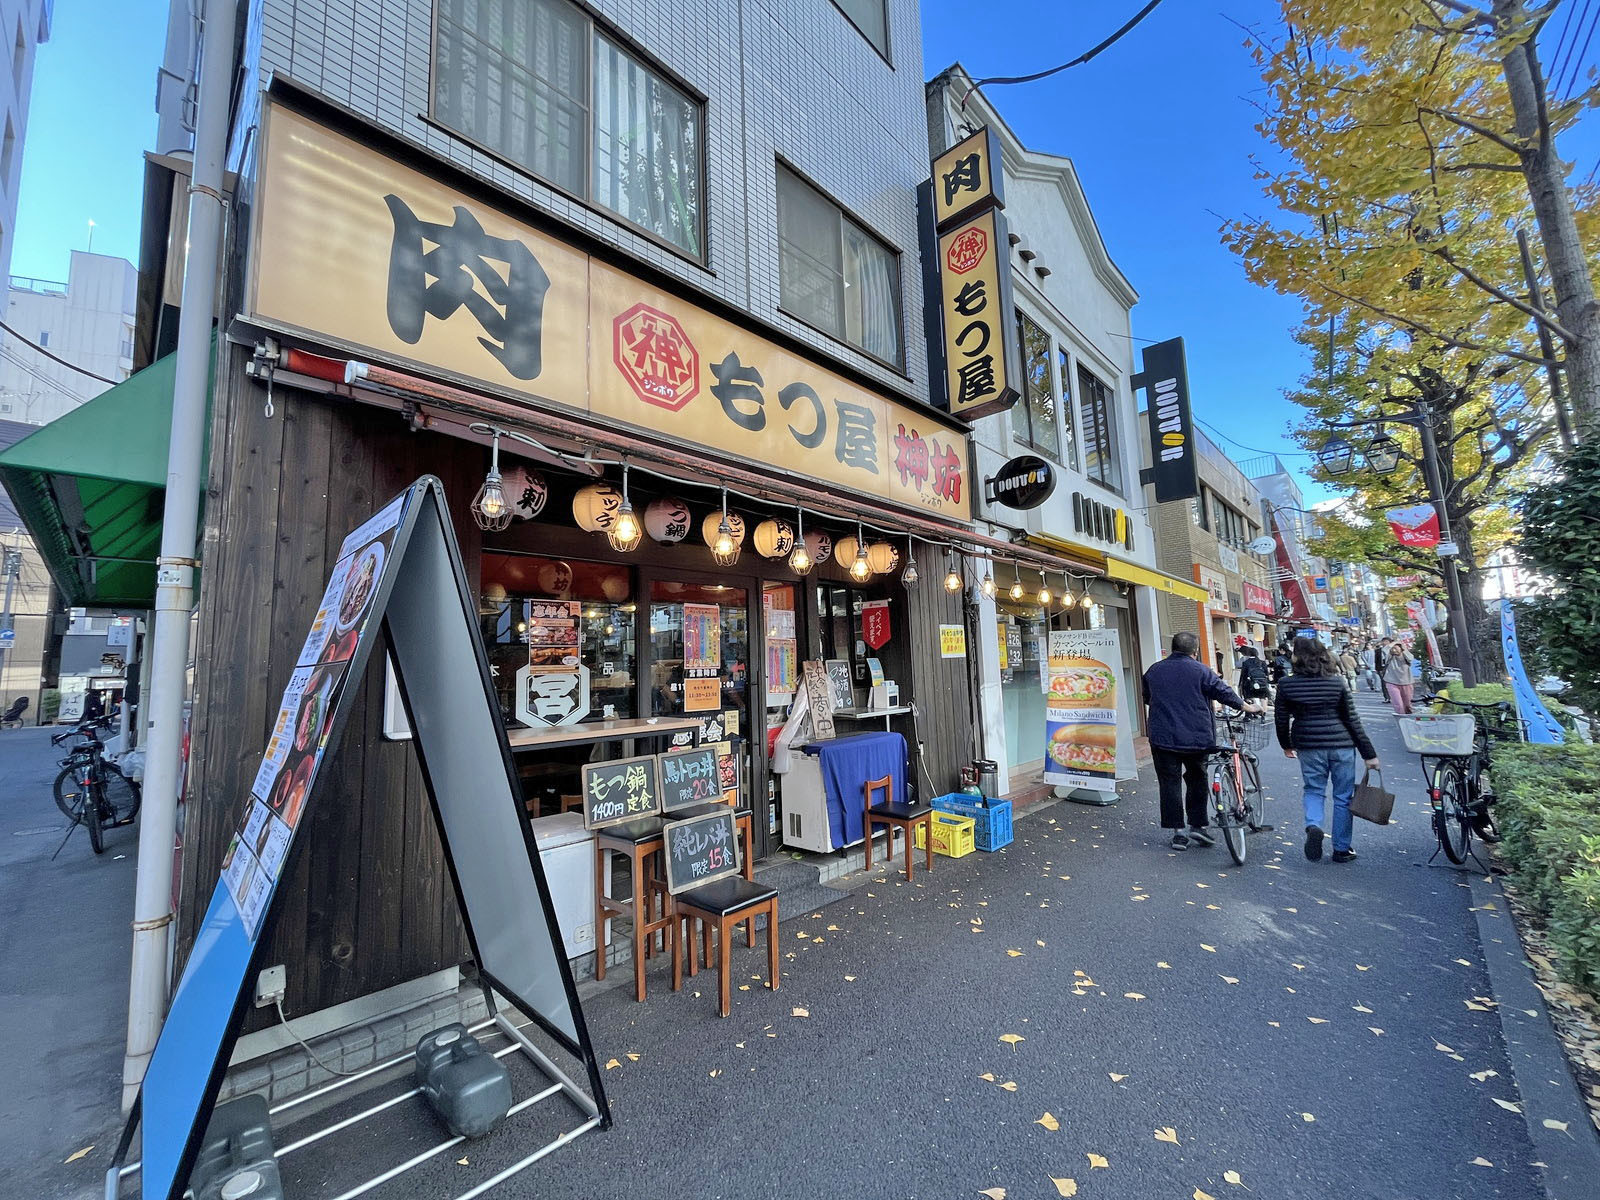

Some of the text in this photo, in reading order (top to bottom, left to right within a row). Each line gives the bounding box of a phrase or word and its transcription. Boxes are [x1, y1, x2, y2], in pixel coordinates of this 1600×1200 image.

[942, 153, 981, 206] 肉
[383, 193, 551, 380] 肉
[709, 351, 879, 475] もつ屋
[894, 423, 961, 504] 神坊
[954, 280, 997, 404] もつ屋
[1154, 377, 1185, 463] DOUTOR
[998, 470, 1046, 493] DOUTOR
[1049, 709, 1073, 718] Milano
[589, 765, 648, 801] もつ鍋
[627, 789, 653, 813] 定食
[591, 801, 625, 822] 1400円
